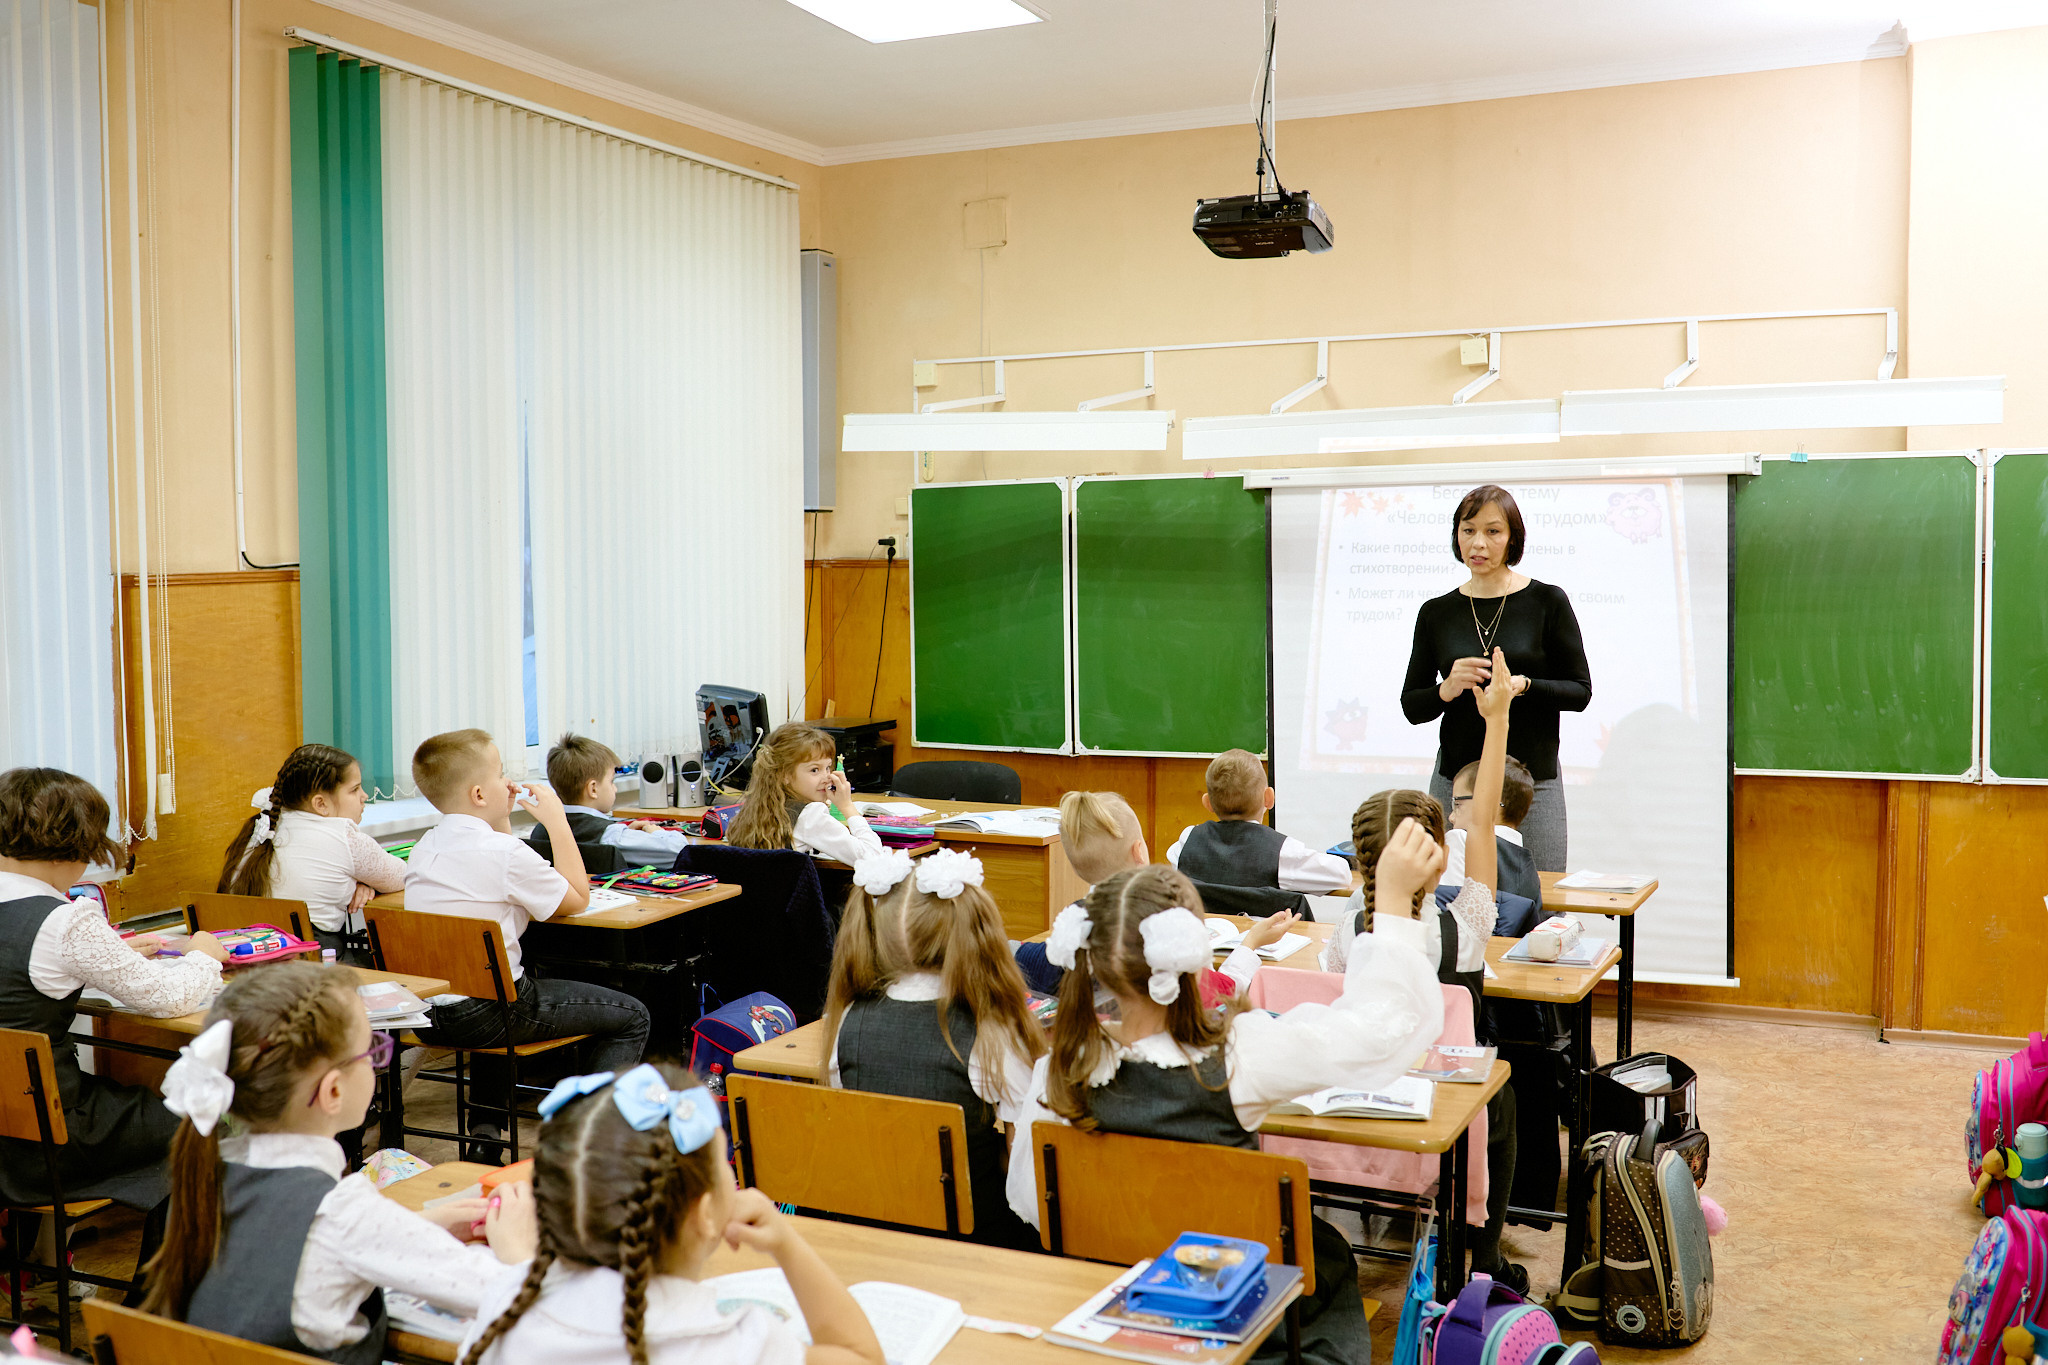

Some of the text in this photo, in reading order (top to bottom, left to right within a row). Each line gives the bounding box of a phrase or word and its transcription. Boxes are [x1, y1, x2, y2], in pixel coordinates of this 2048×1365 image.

[1520, 487, 1560, 502] тему
[1387, 510, 1454, 525] «Челове
[1534, 512, 1607, 528] трудом»
[1351, 542, 1390, 554] Какие
[1393, 541, 1452, 556] професс
[1568, 545, 1576, 555] в
[1349, 562, 1457, 577] стихотворении?
[1348, 587, 1394, 600] Может
[1397, 589, 1414, 600] ли
[1578, 592, 1625, 604] своим
[1346, 607, 1403, 624] трудом?
